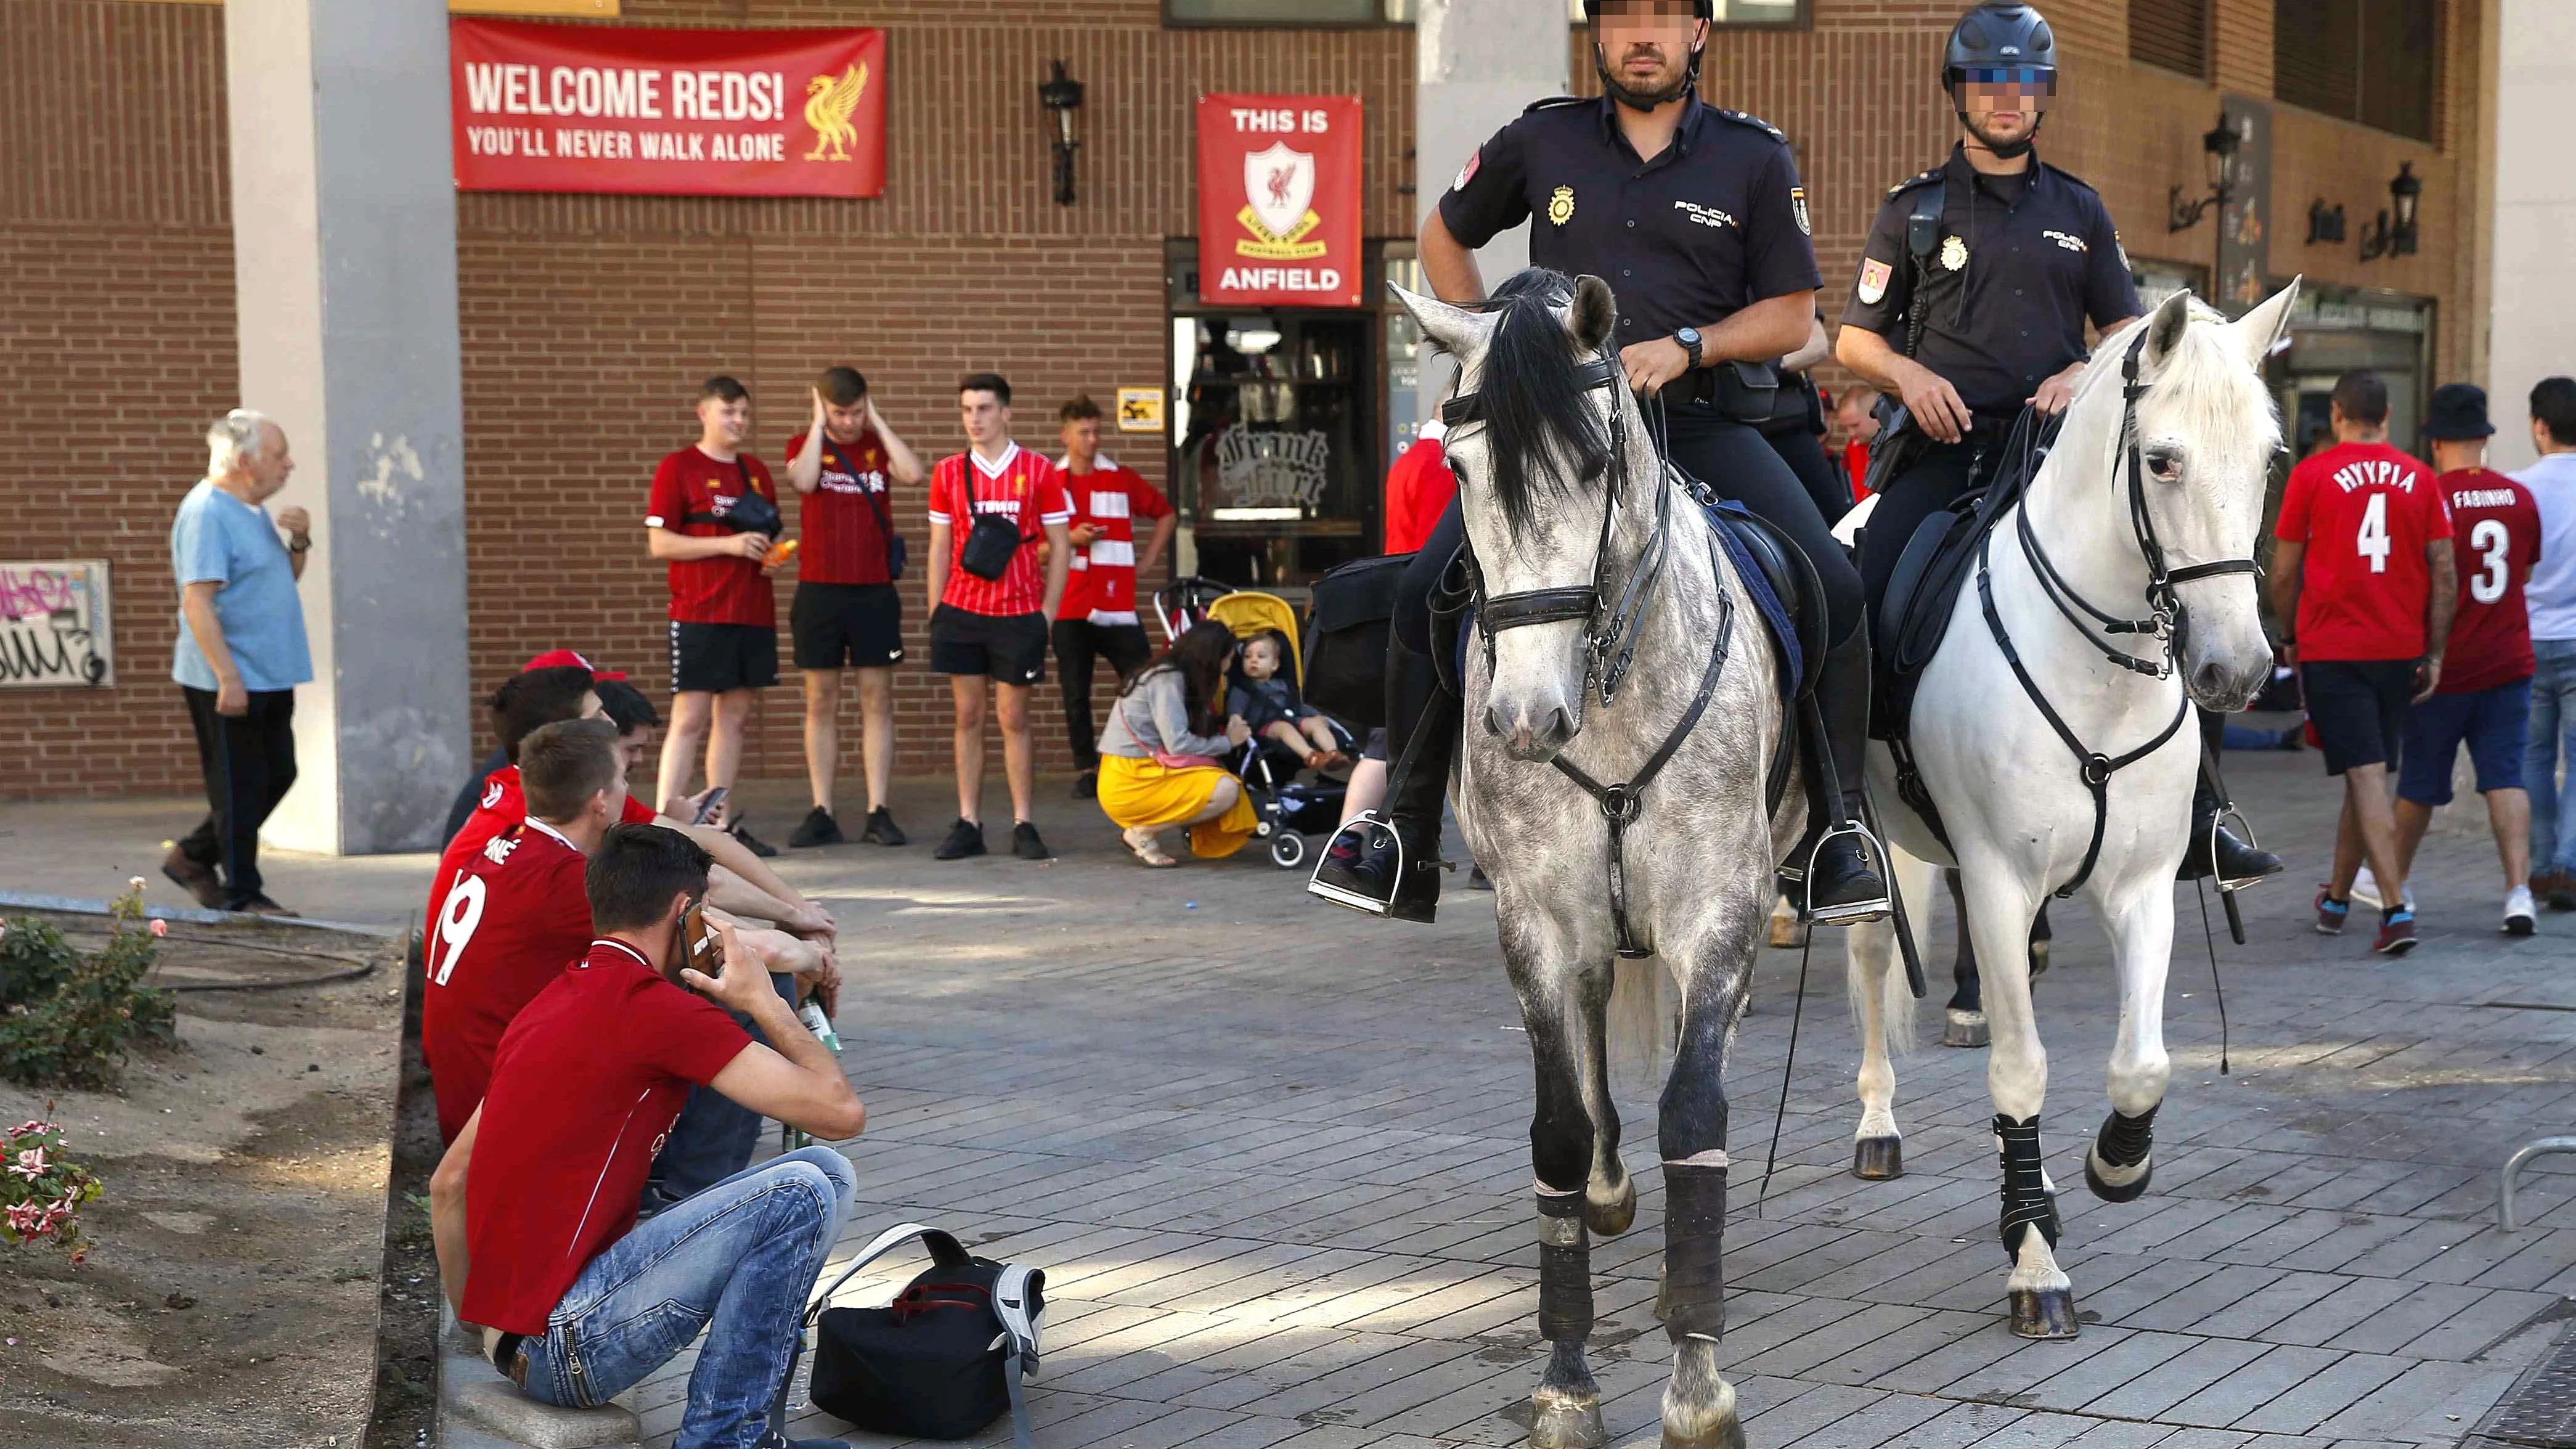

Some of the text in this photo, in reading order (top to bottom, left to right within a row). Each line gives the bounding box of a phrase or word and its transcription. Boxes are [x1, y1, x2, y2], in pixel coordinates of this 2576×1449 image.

[465, 62, 785, 121] WELCOME REDS!
[1230, 108, 1329, 134] THIS IS
[466, 126, 785, 163] YOU'LL NEVER WALK ALONE
[1674, 200, 1733, 224] POLICIA
[1690, 213, 1722, 227] CNP
[1219, 266, 1341, 291] ANFIELD
[2333, 459, 2417, 494] HYYPIA
[2452, 488, 2516, 510] FABINHO
[2357, 492, 2391, 573] 4
[2470, 518, 2510, 605] 3
[426, 868, 487, 987] 19
